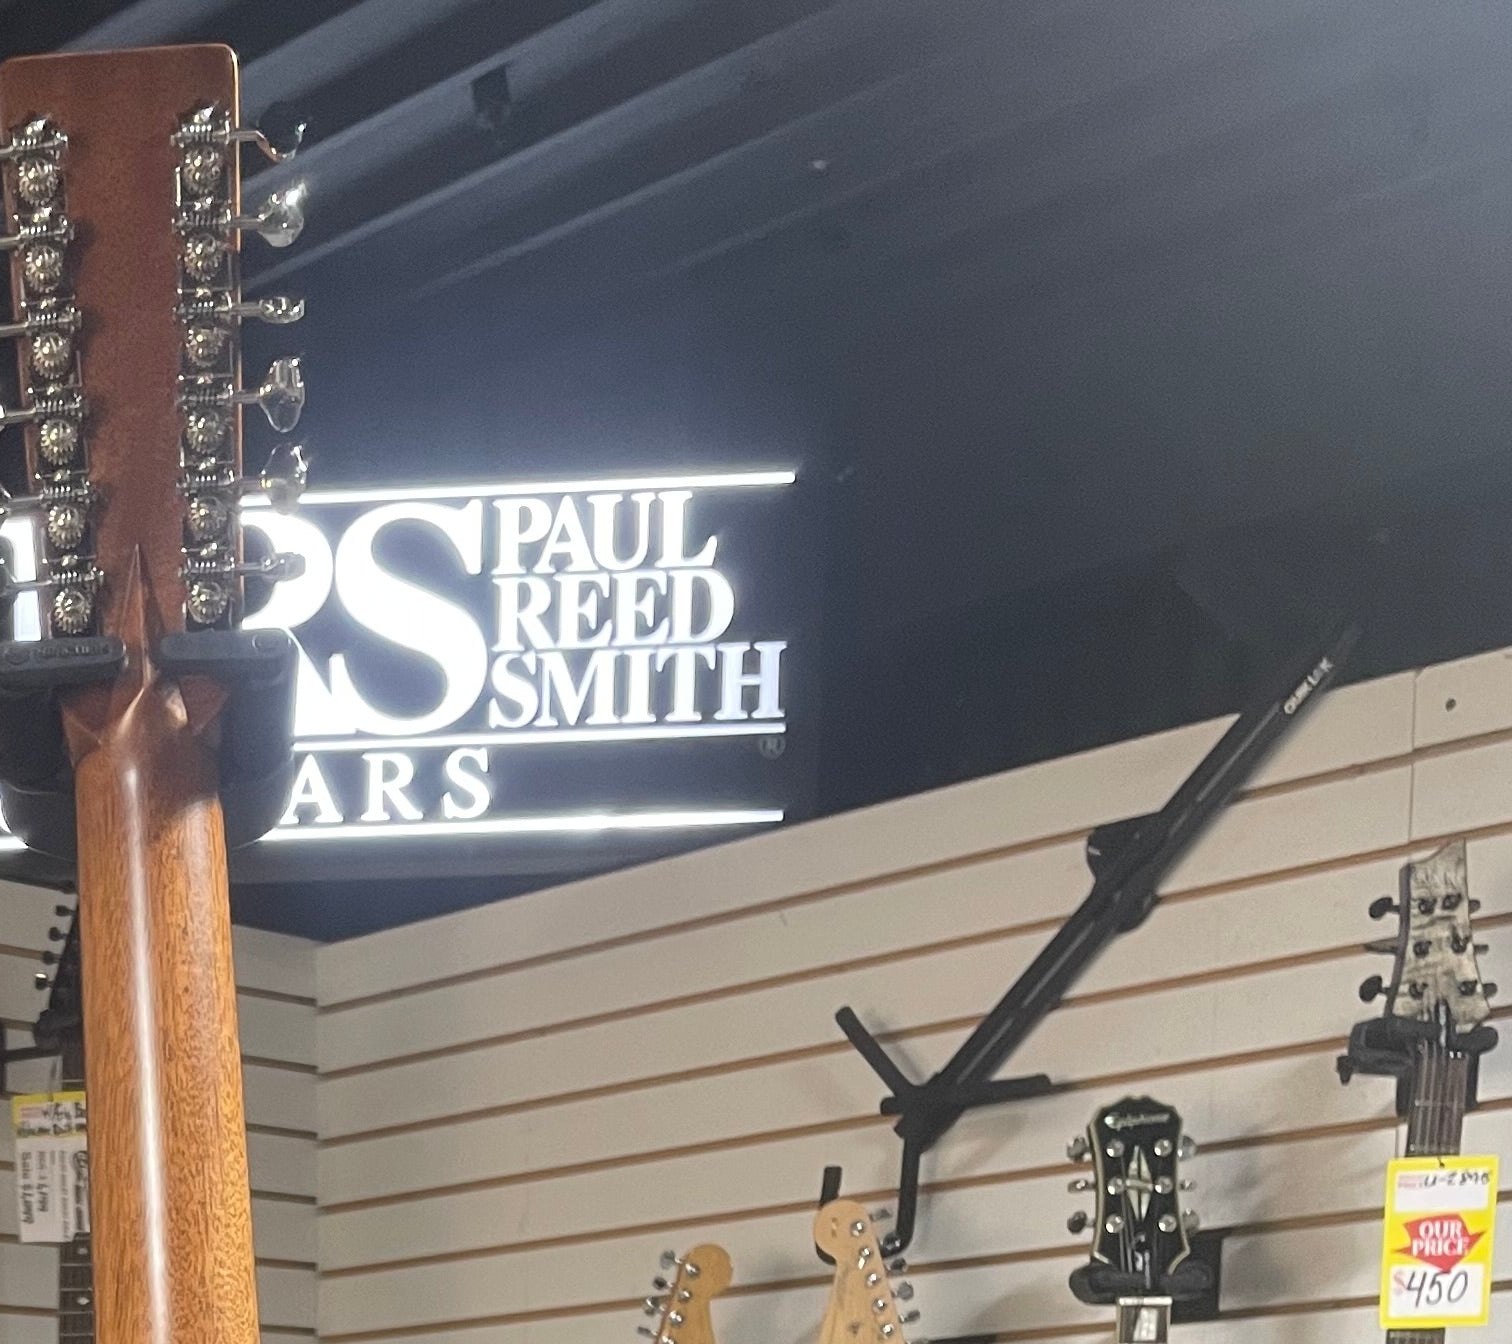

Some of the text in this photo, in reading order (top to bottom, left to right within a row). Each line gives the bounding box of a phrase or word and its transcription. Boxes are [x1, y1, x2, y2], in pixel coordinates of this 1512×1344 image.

[494, 491, 717, 571] PAUL
[494, 570, 735, 649] REED
[489, 641, 786, 728] SMITH
[1411, 1236, 1470, 1257] PRICE
[1419, 1219, 1462, 1238] OUR
